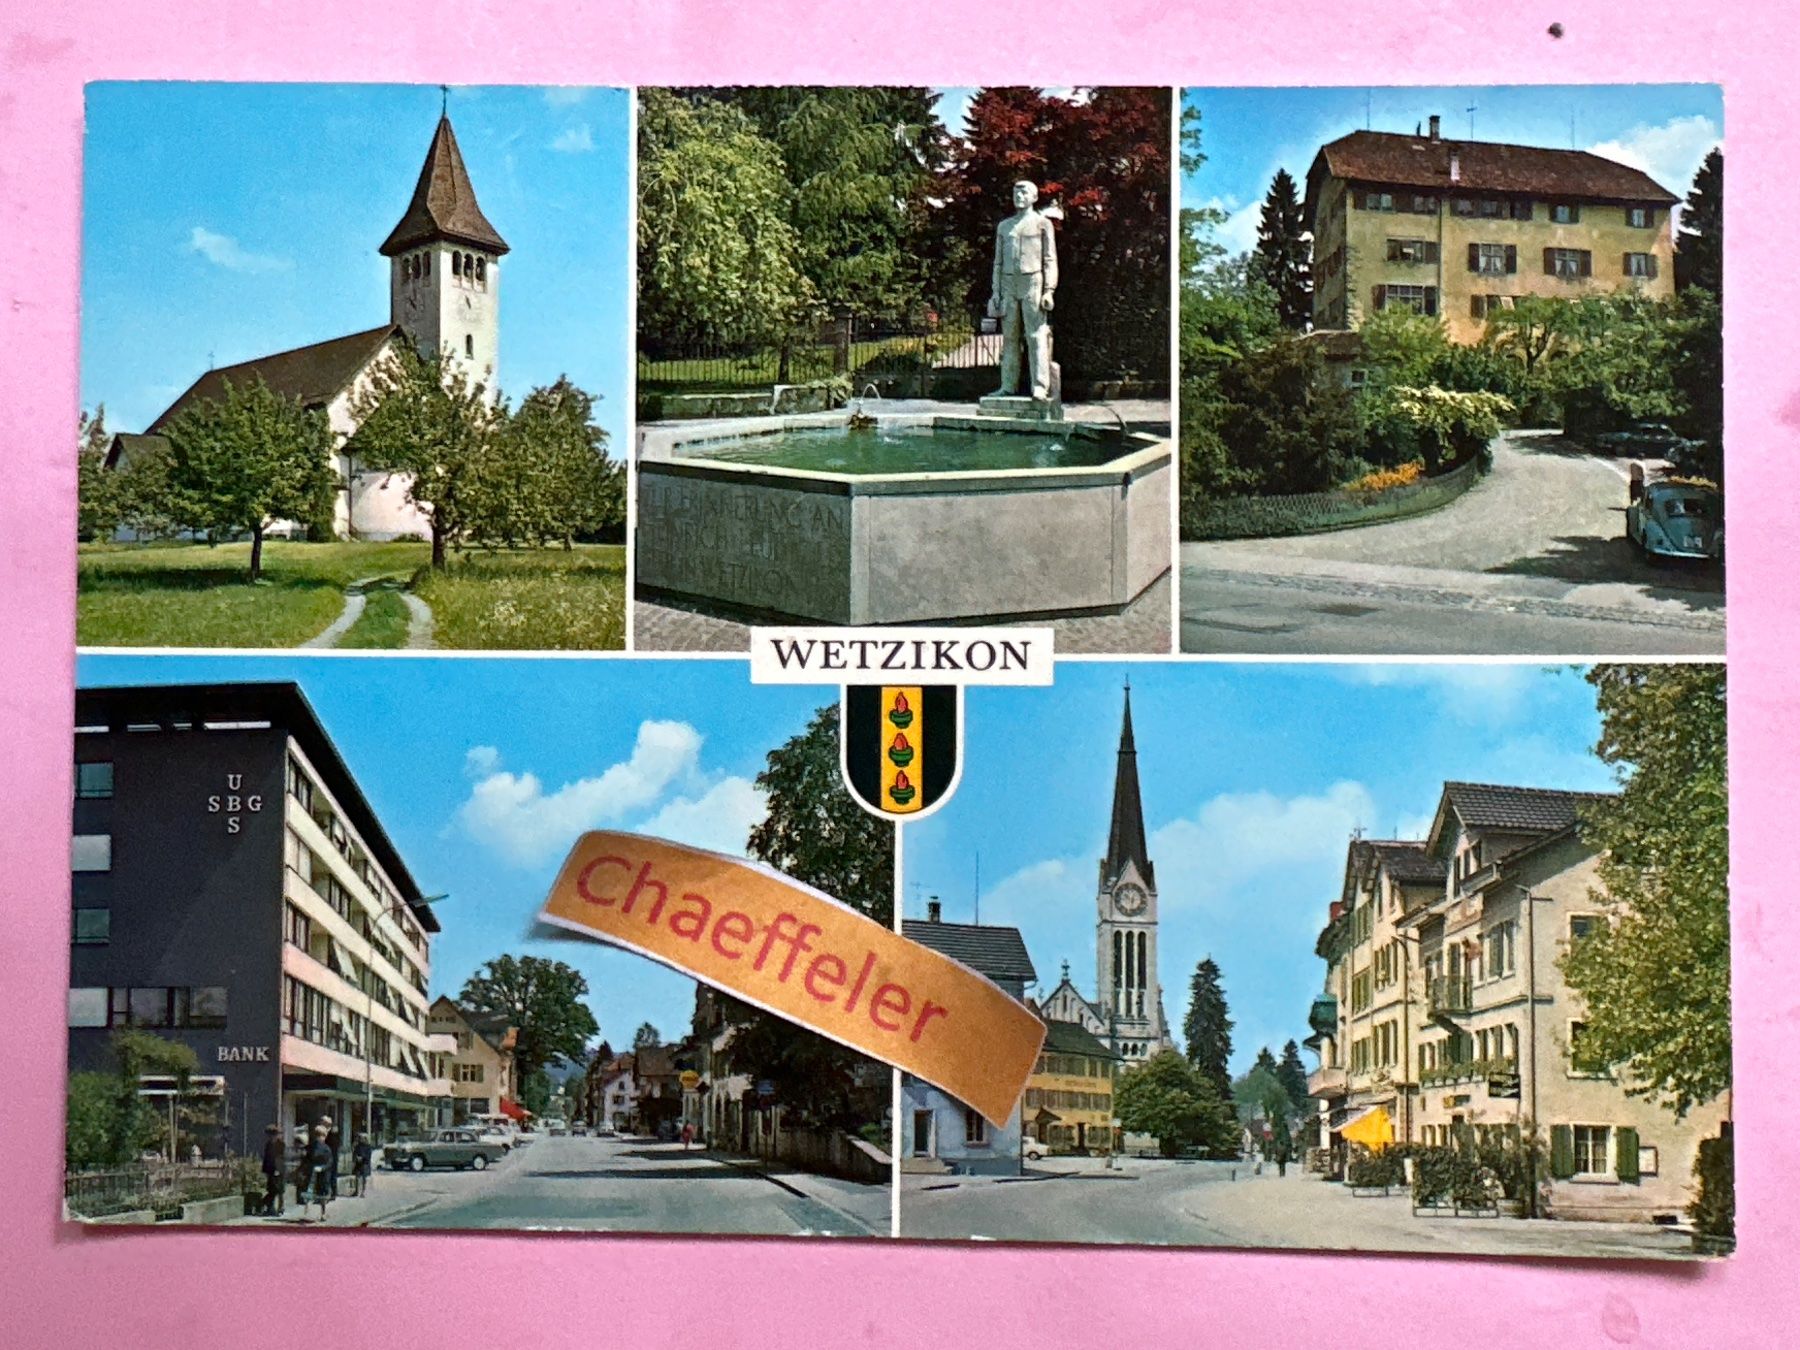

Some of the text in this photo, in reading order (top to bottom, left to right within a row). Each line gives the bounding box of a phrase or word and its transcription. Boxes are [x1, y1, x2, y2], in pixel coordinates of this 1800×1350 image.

[770, 639, 1032, 671] WETZIKON
[576, 855, 948, 1043] Chaeffeler
[218, 1046, 270, 1061] BANK
